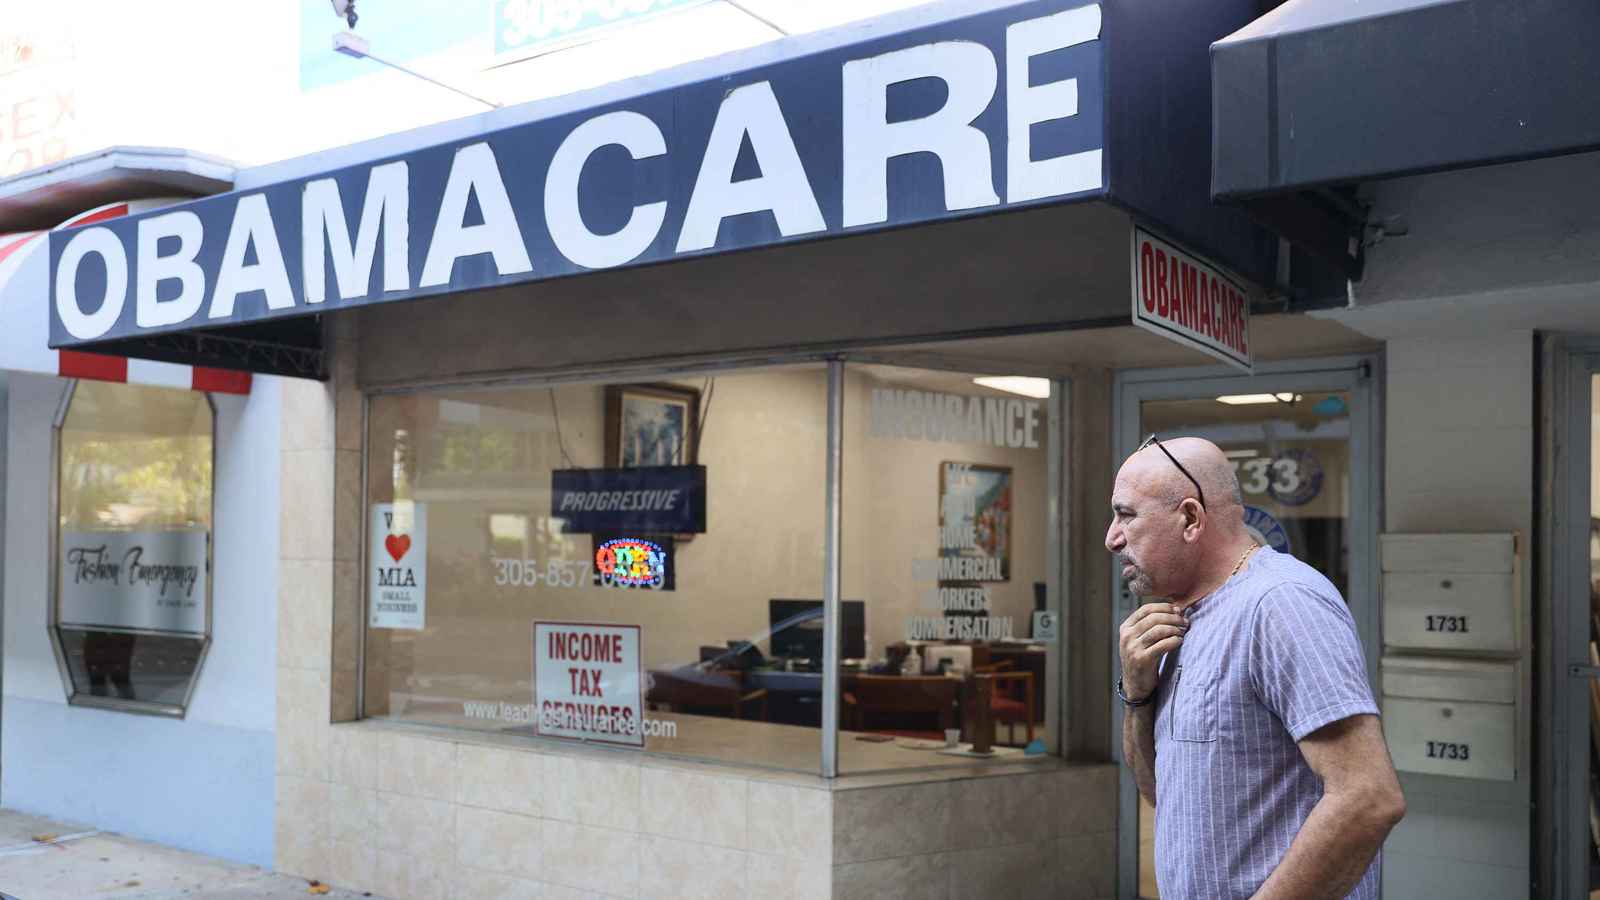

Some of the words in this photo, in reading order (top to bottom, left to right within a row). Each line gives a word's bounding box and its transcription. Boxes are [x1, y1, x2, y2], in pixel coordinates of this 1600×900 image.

[56, 3, 1103, 341] OBAMACARE
[1141, 241, 1247, 355] OBAMACARE
[871, 389, 1039, 448] INSURANCE
[1232, 457, 1299, 493] 33
[560, 489, 680, 511] PROGRESSIVE
[378, 567, 416, 587] MIA
[596, 546, 666, 578] OPEN
[1425, 615, 1469, 633] 1731
[549, 632, 622, 663] INCOME
[568, 668, 603, 697] TAX
[543, 699, 633, 736] SERVICES
[1427, 741, 1469, 761] 1733
